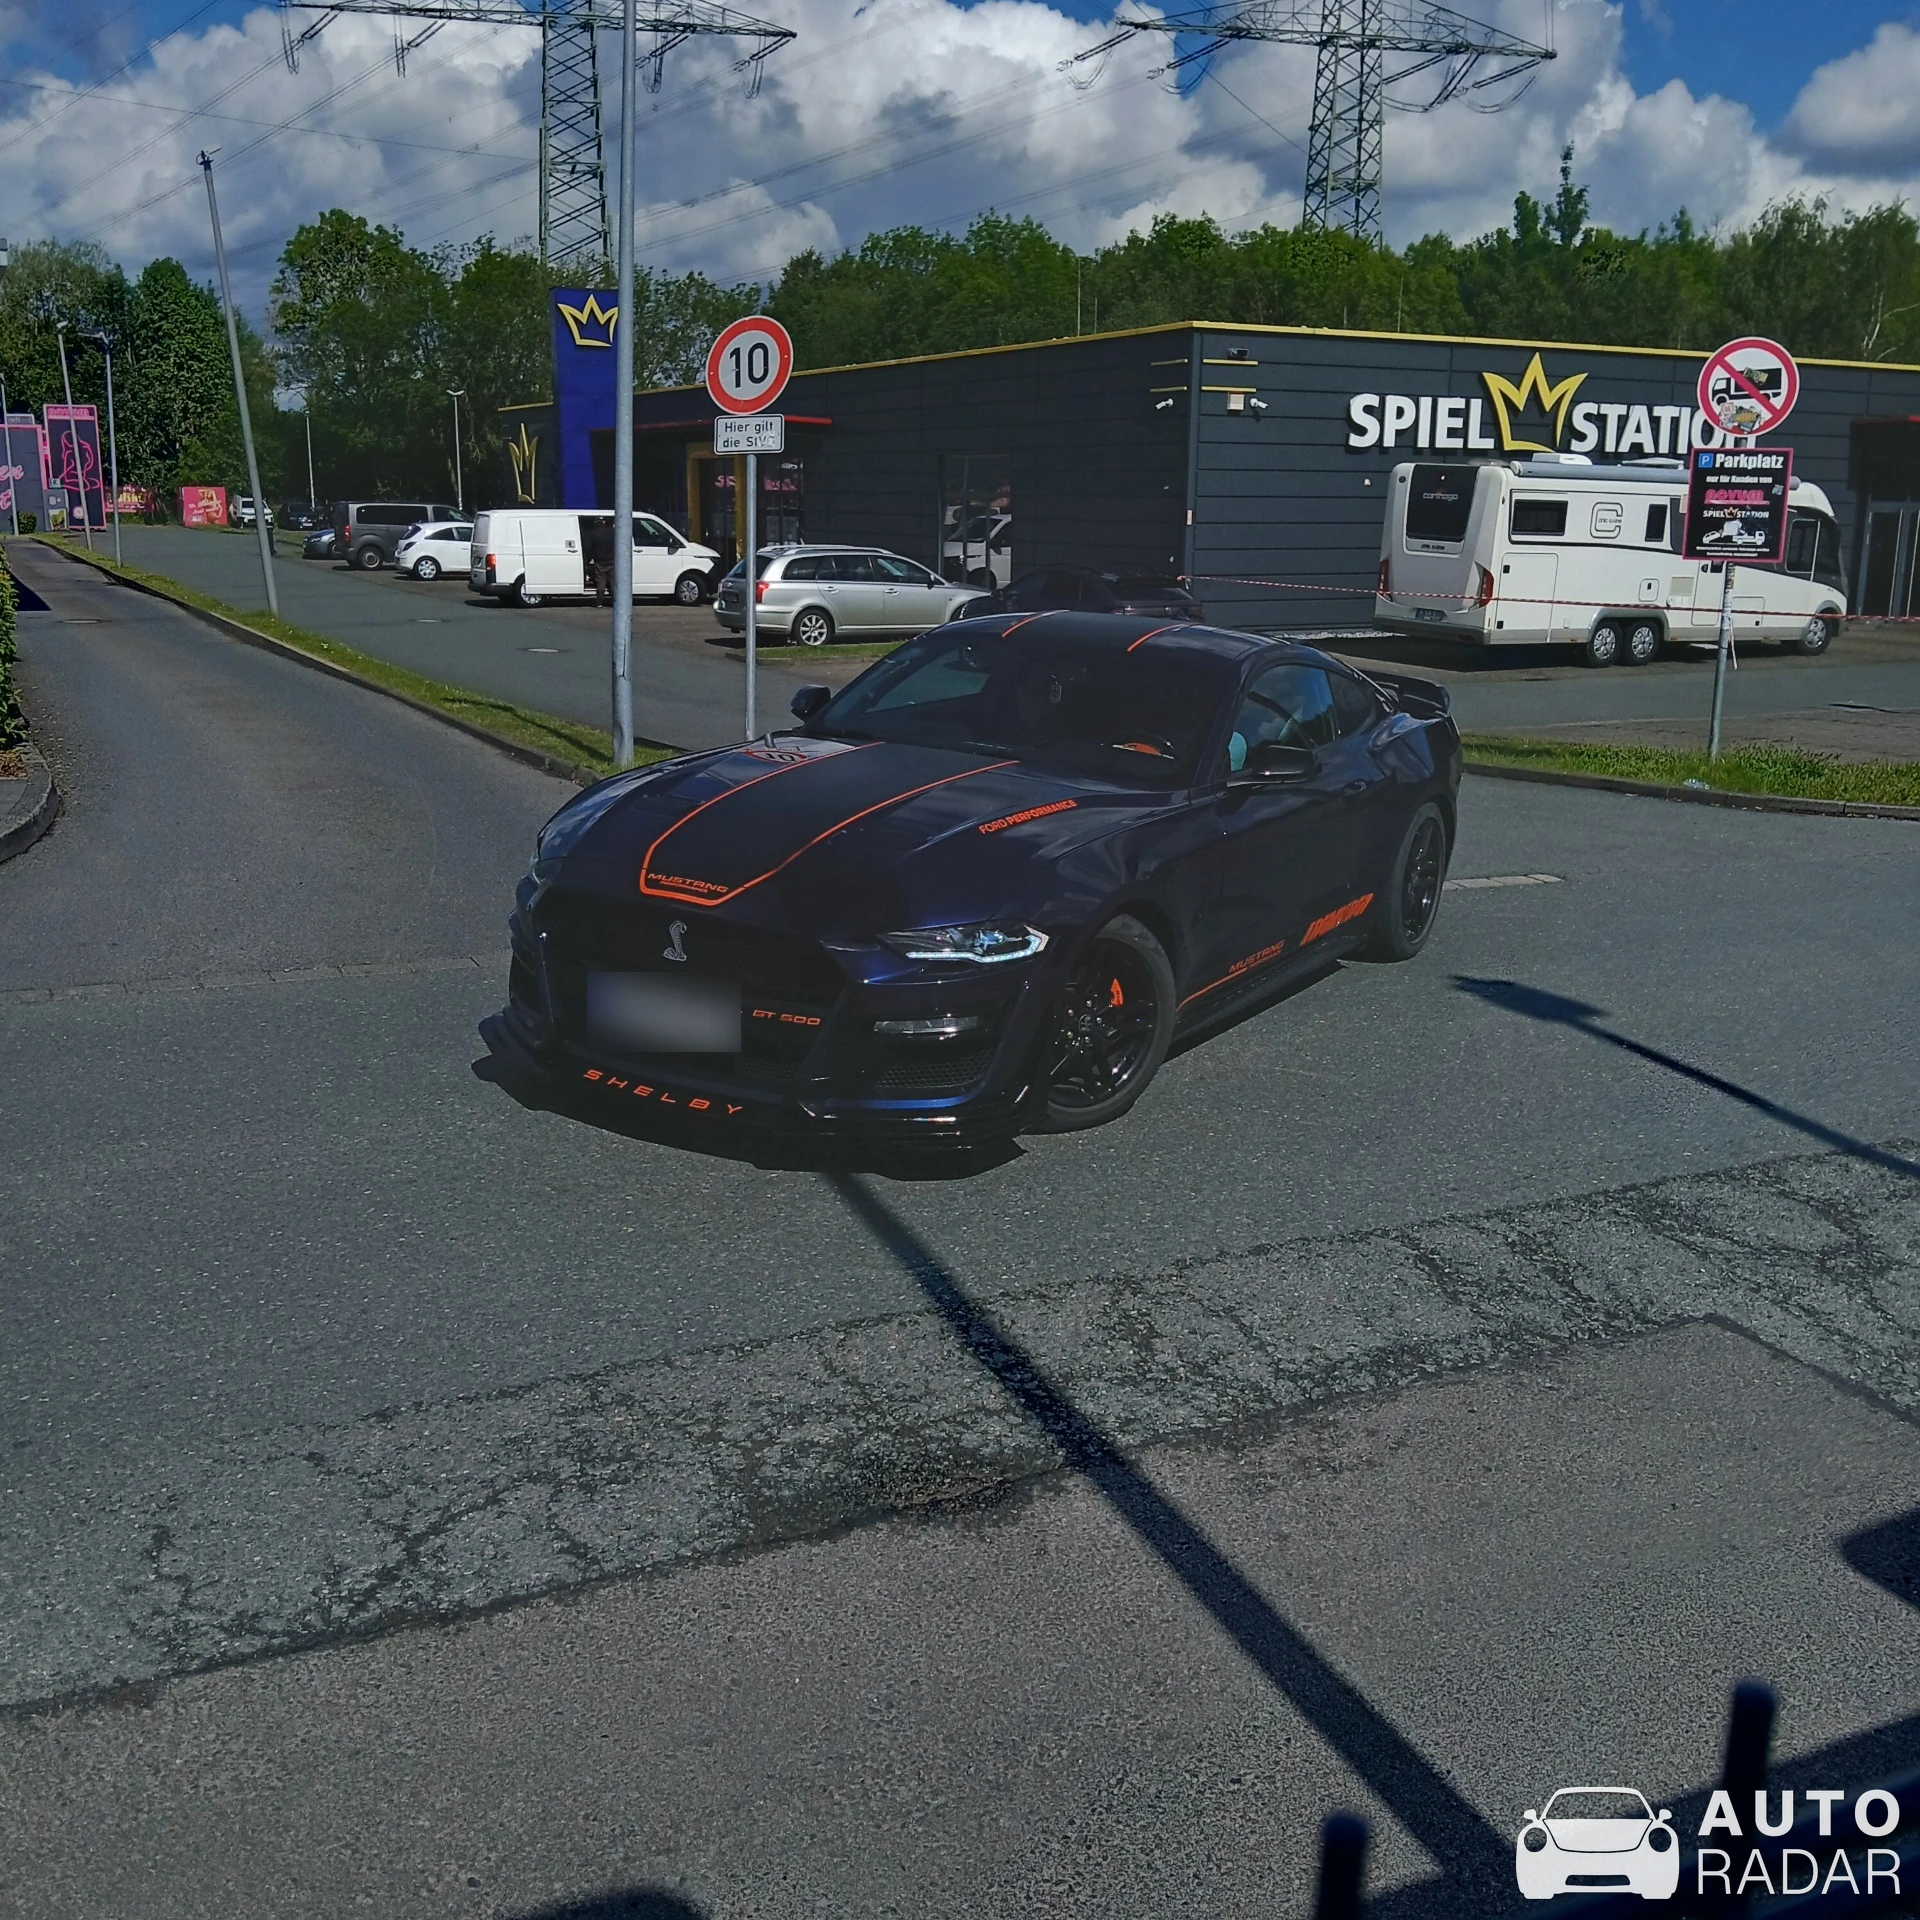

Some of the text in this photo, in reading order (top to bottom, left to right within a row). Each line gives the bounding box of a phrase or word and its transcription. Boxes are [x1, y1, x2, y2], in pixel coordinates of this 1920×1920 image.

[729, 342, 769, 389] 10
[724, 420, 774, 434] Hier gilt
[1347, 393, 1495, 449] SPIEL
[722, 437, 741, 448] die
[1715, 453, 1784, 470] Parkplatz
[1731, 475, 1759, 484] Kunden
[1703, 510, 1725, 518] SPIEL
[978, 799, 1078, 835] FORD PERFORMANCE
[647, 873, 729, 893] MUSTANG
[1229, 939, 1285, 973] MUSTANG
[752, 1009, 821, 1025] GT 500
[583, 1069, 744, 1114] SHELBY
